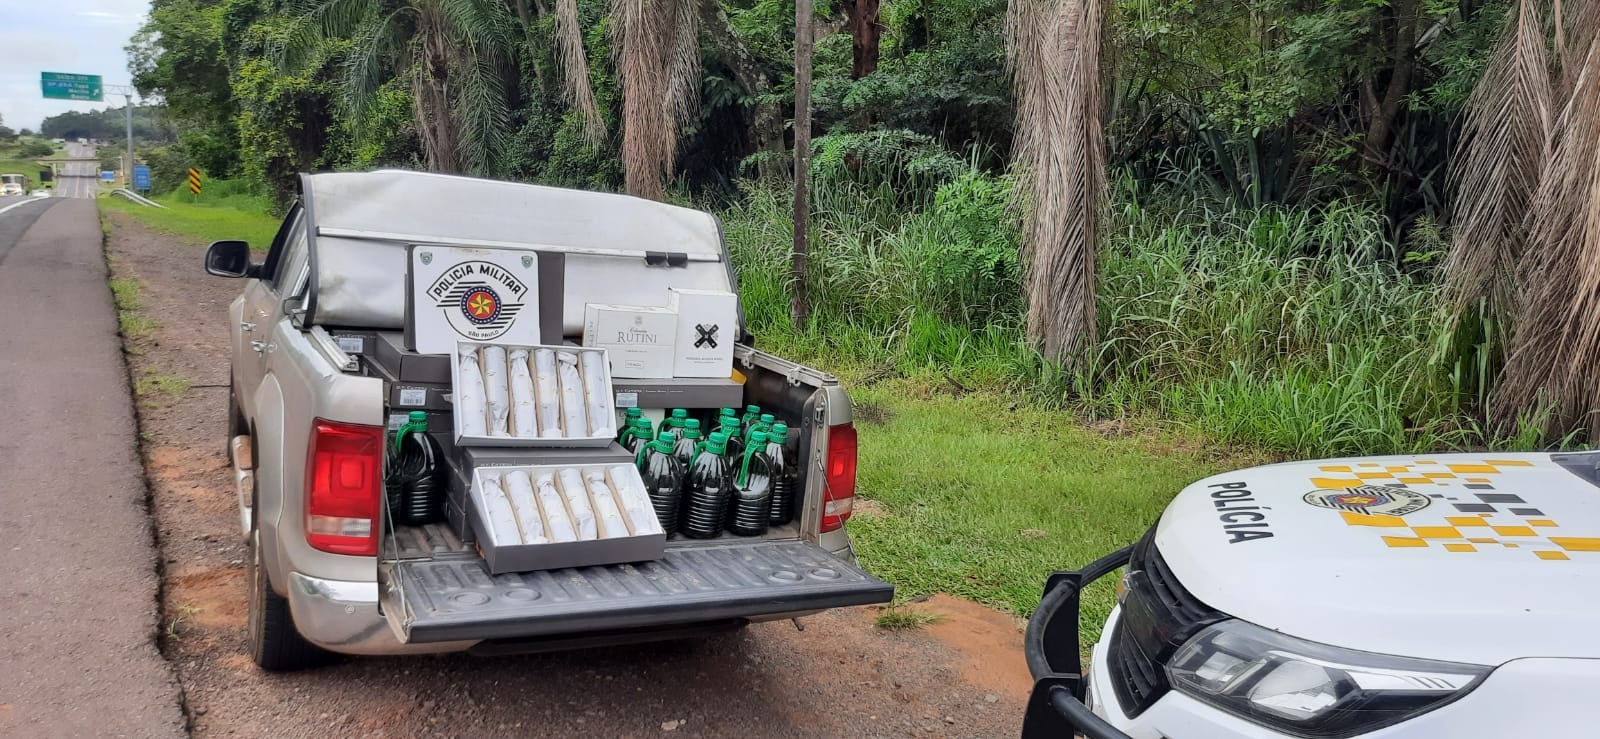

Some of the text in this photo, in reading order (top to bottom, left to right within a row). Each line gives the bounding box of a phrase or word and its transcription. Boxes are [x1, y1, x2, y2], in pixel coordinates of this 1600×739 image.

[434, 264, 521, 297] POLICIA MILITAR
[481, 330, 499, 338] PAULO
[617, 331, 656, 344] RUTINI
[1207, 482, 1274, 544] POLÍCIA
